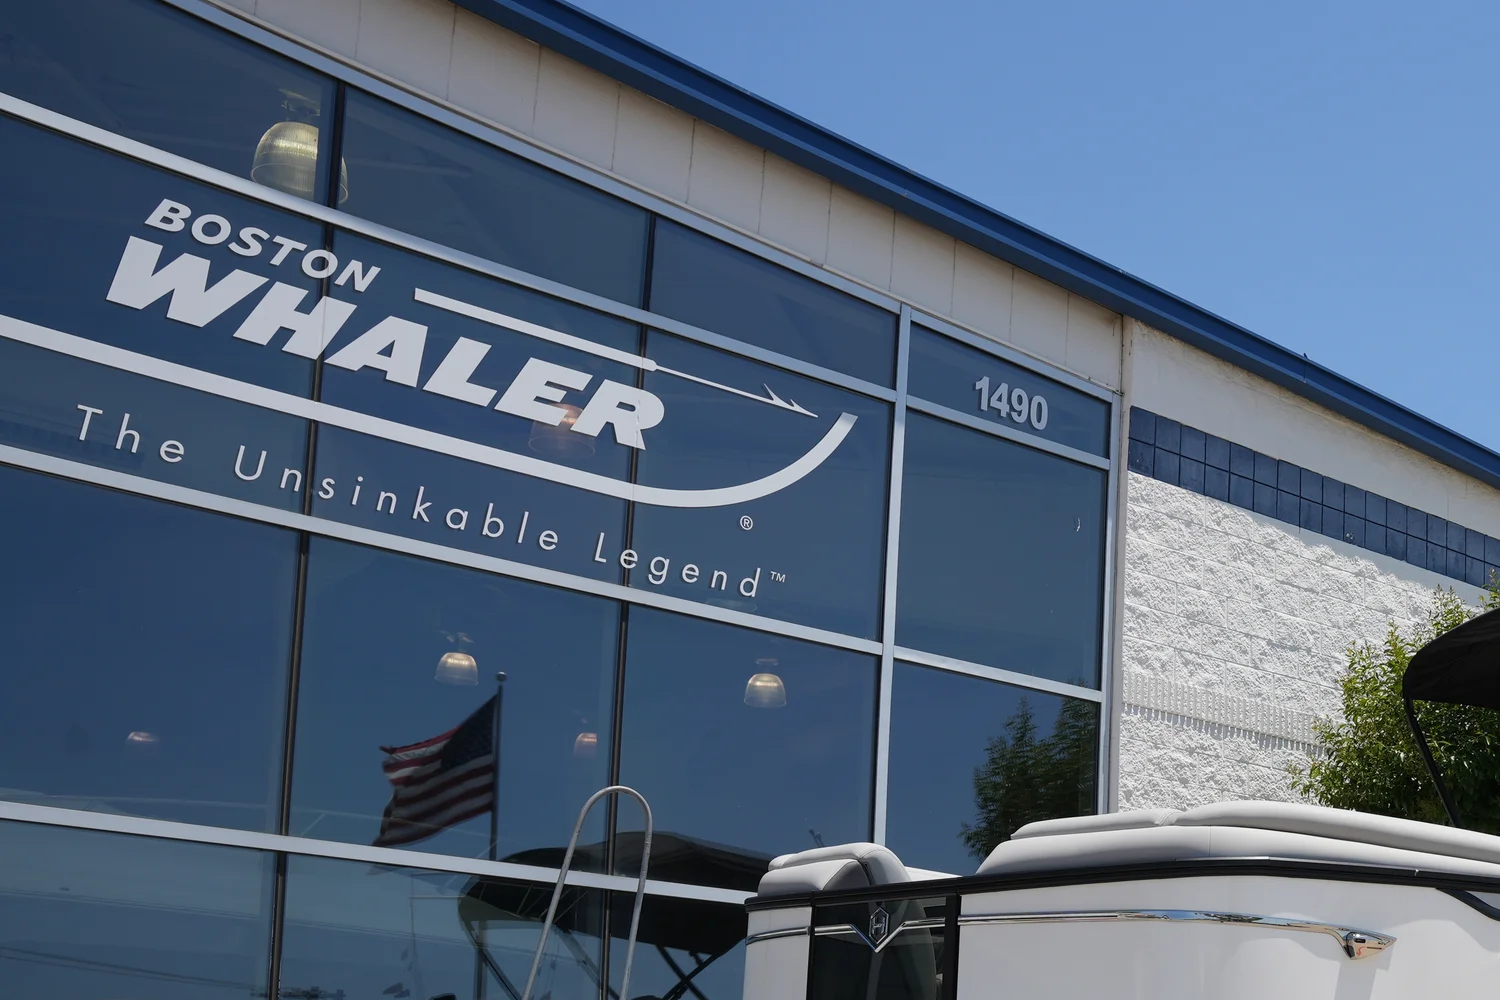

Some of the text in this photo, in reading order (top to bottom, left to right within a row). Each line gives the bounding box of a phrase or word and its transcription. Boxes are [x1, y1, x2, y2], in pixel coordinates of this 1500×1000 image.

[145, 198, 381, 293] BOSTON
[105, 235, 665, 451] WHALER
[975, 375, 1049, 431] 1490
[77, 403, 185, 463] The
[234, 444, 560, 552] Unsinkable
